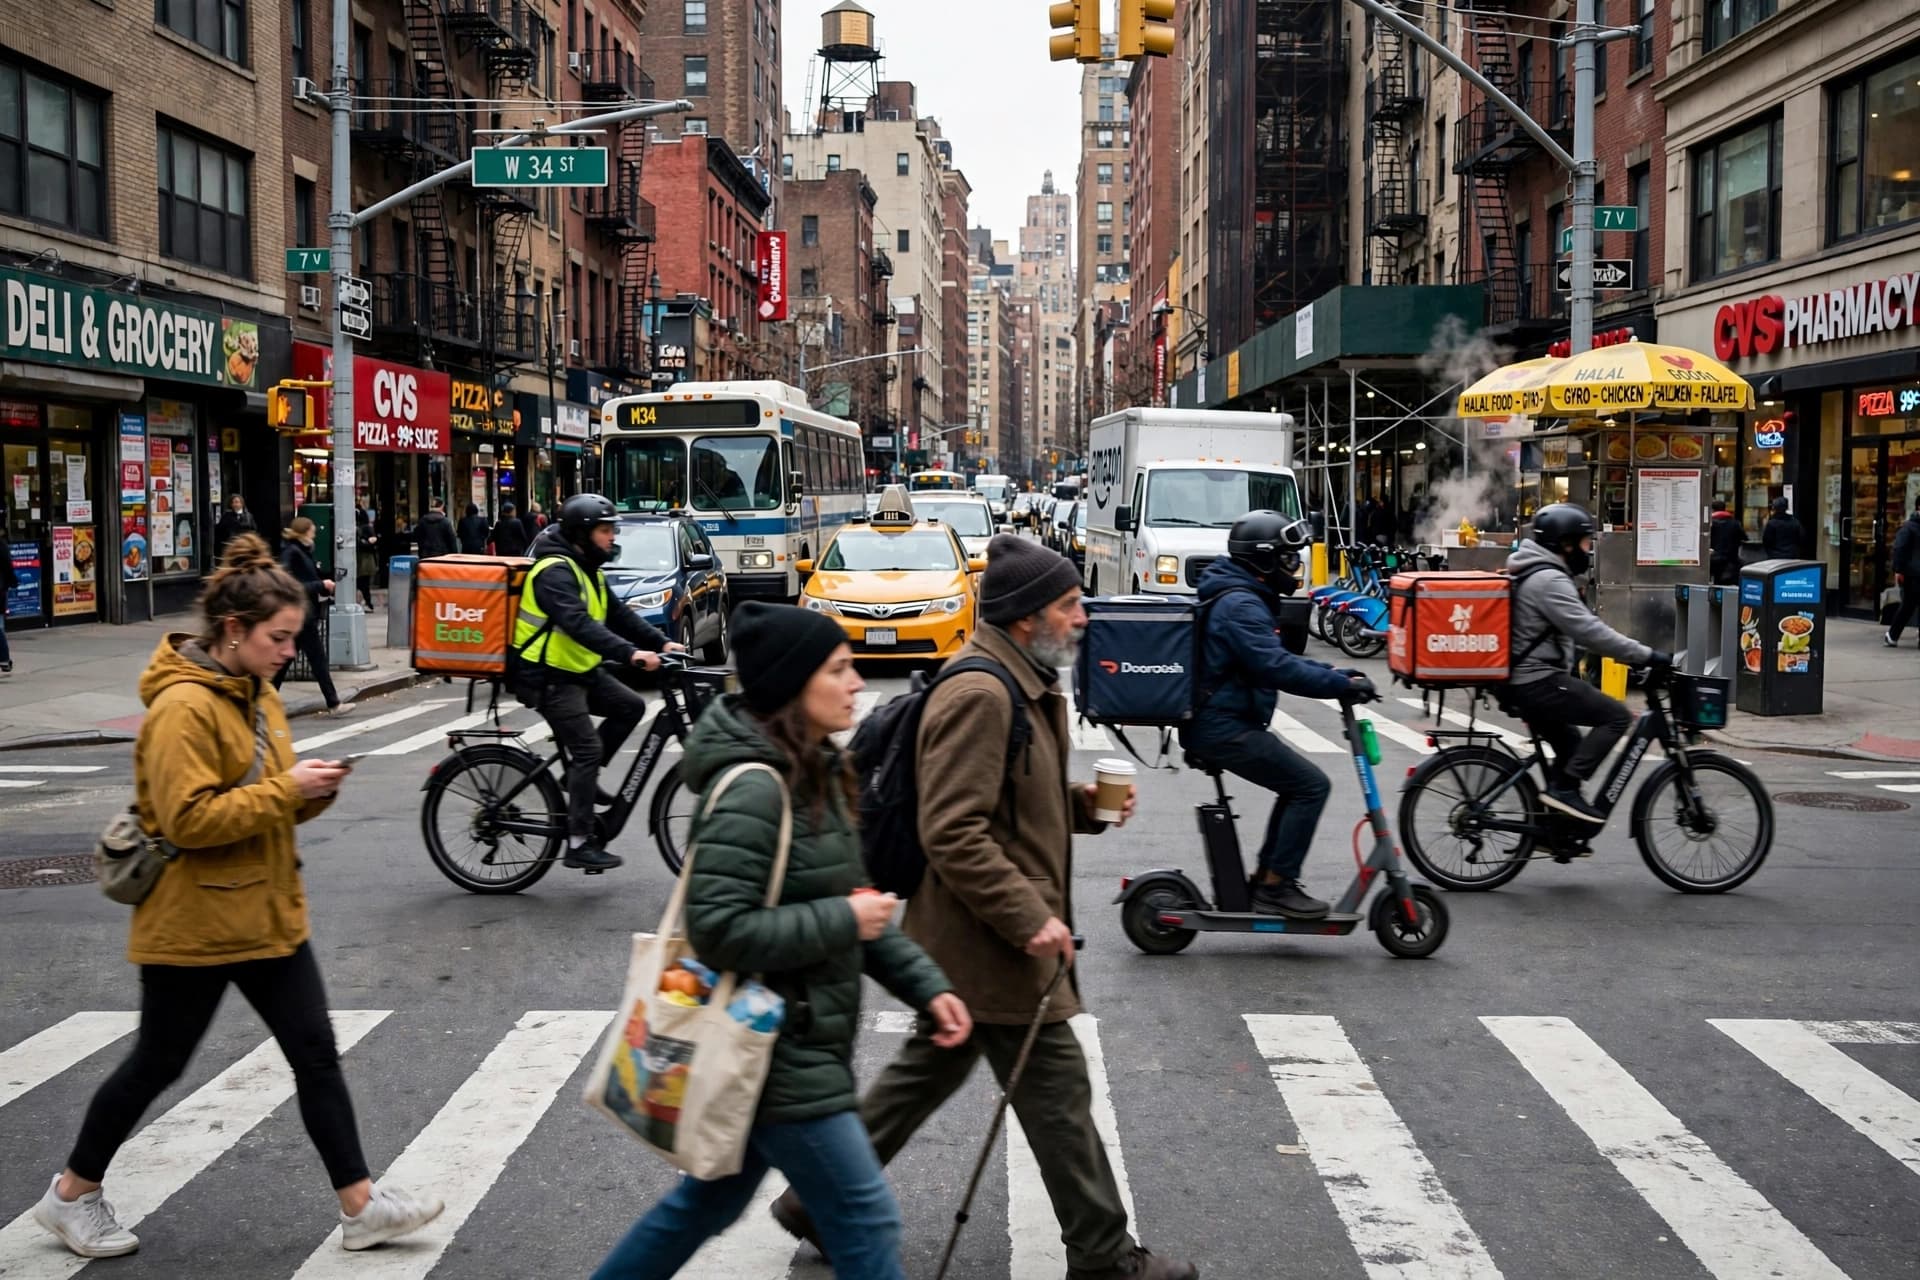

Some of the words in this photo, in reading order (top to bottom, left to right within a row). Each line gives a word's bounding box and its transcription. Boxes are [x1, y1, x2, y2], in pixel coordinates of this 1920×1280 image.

[504, 156, 520, 180] W
[528, 155, 554, 179] 34
[1602, 210, 1612, 227] 7
[299, 252, 309, 269] 7
[7, 278, 72, 354] DELI
[80, 295, 100, 359] &
[1714, 295, 1784, 361] CVS
[1784, 271, 1920, 348] PHARMACY
[1574, 367, 1625, 381] HALAL
[373, 368, 418, 422] CVS
[451, 380, 490, 412] PIZZA
[1464, 395, 1489, 412] HALAL
[1491, 394, 1513, 411] FOOD
[1564, 387, 1590, 405] GYRO
[1600, 385, 1644, 404] CHICKEN
[1701, 385, 1739, 403] FALAFEL
[1859, 390, 1895, 416] PIZZA
[631, 406, 656, 425] M34
[358, 421, 389, 446] PIZZA
[415, 427, 439, 449] SLICE
[435, 602, 487, 623] Uber
[435, 623, 485, 644] Eats
